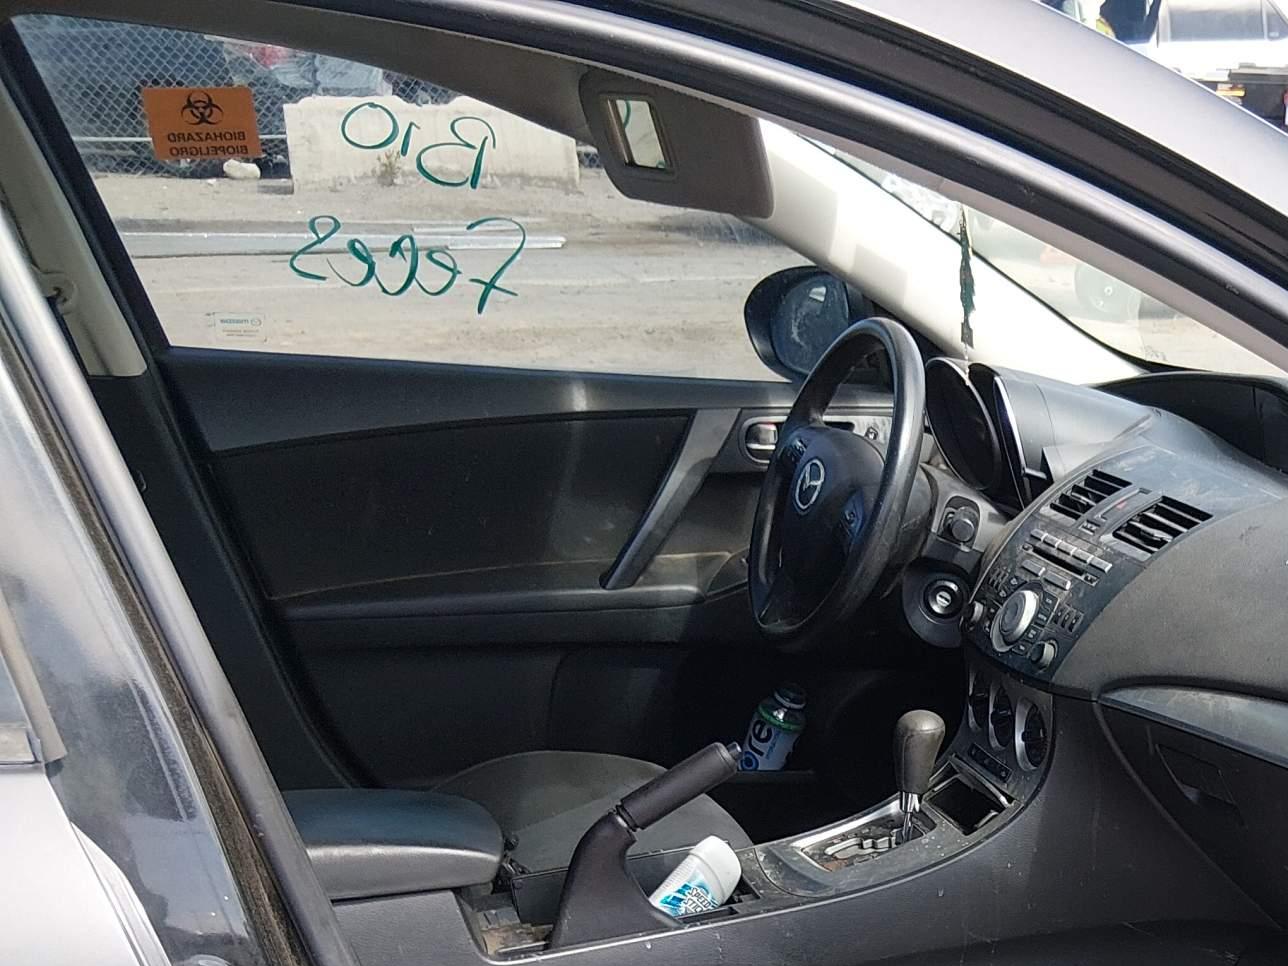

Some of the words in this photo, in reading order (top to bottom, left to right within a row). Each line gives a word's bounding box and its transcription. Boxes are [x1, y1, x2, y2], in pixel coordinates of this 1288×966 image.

[741, 720, 773, 770] ore
[683, 898, 704, 914] STIC
[689, 887, 712, 909] SPEED
